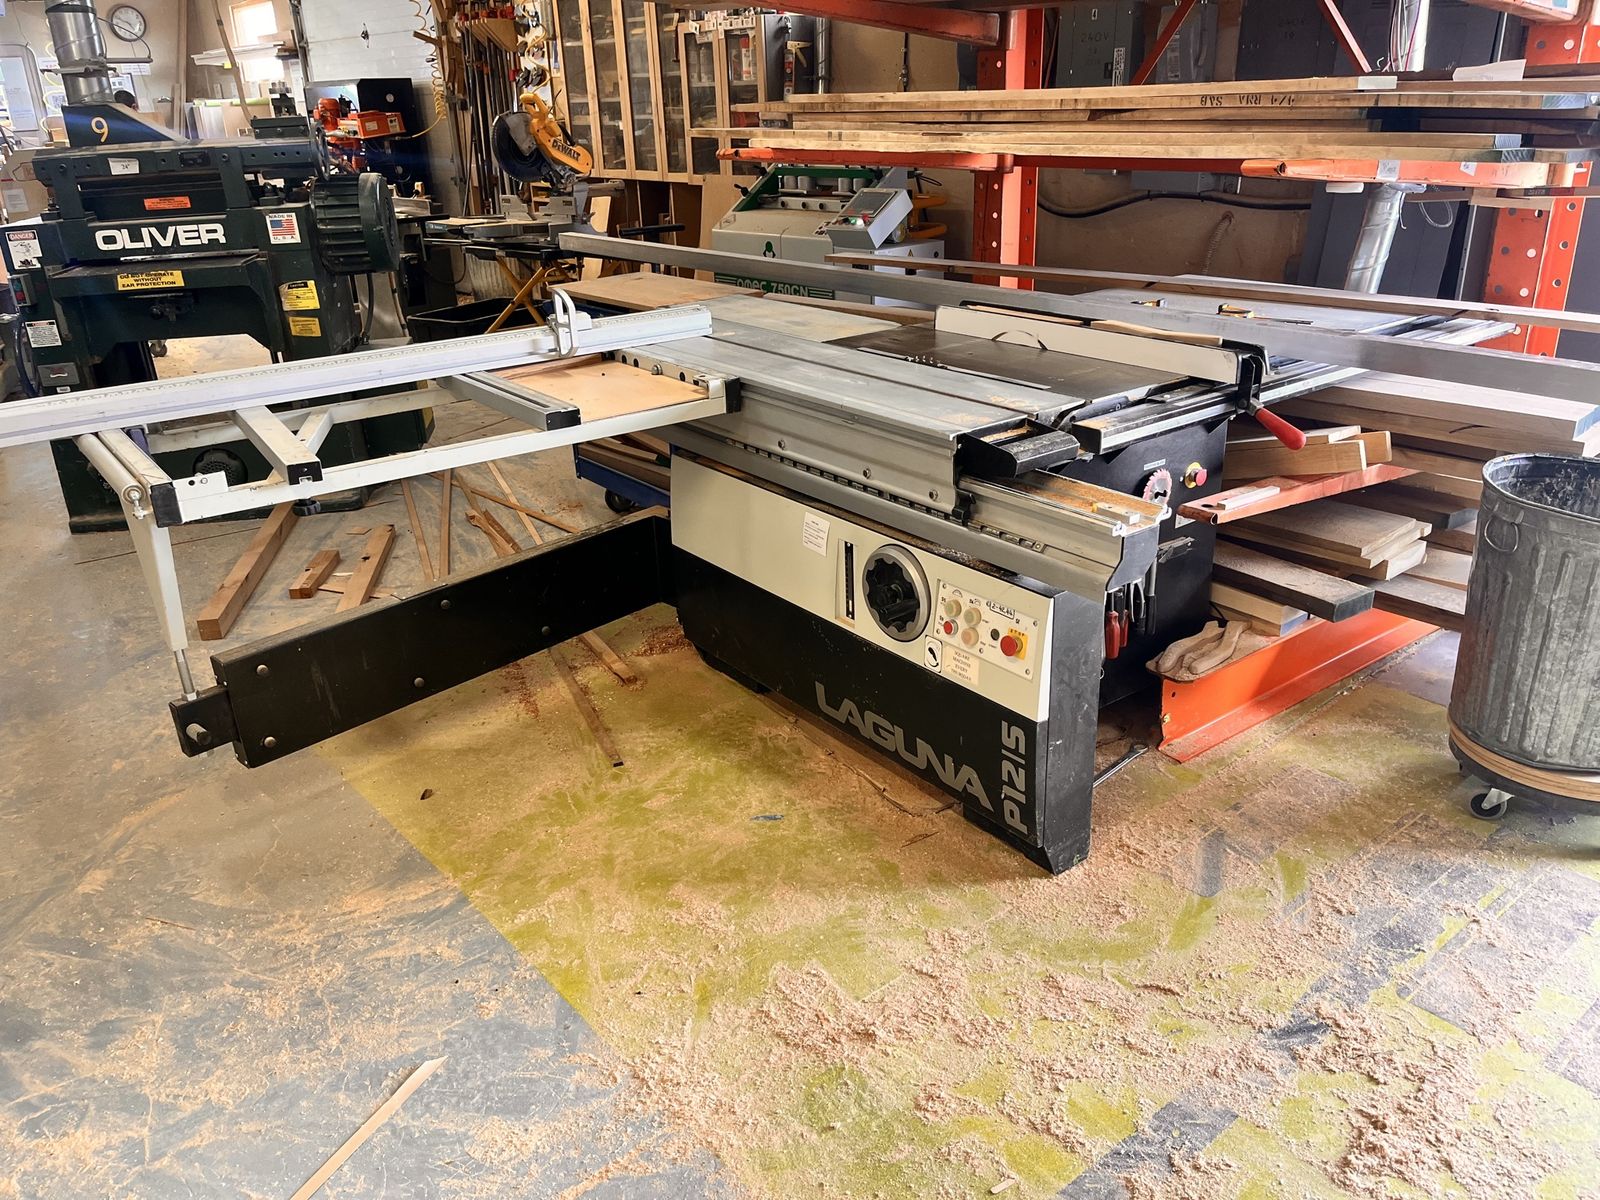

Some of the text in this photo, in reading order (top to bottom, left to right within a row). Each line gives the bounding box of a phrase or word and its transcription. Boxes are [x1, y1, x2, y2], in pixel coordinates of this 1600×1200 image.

[1080, 31, 1109, 43] 240V
[91, 117, 109, 143] 9
[8, 232, 35, 241] DANGER
[95, 223, 226, 251] OLIVER
[1010, 628, 1025, 637] STOP
[815, 680, 994, 813] LAGUNA
